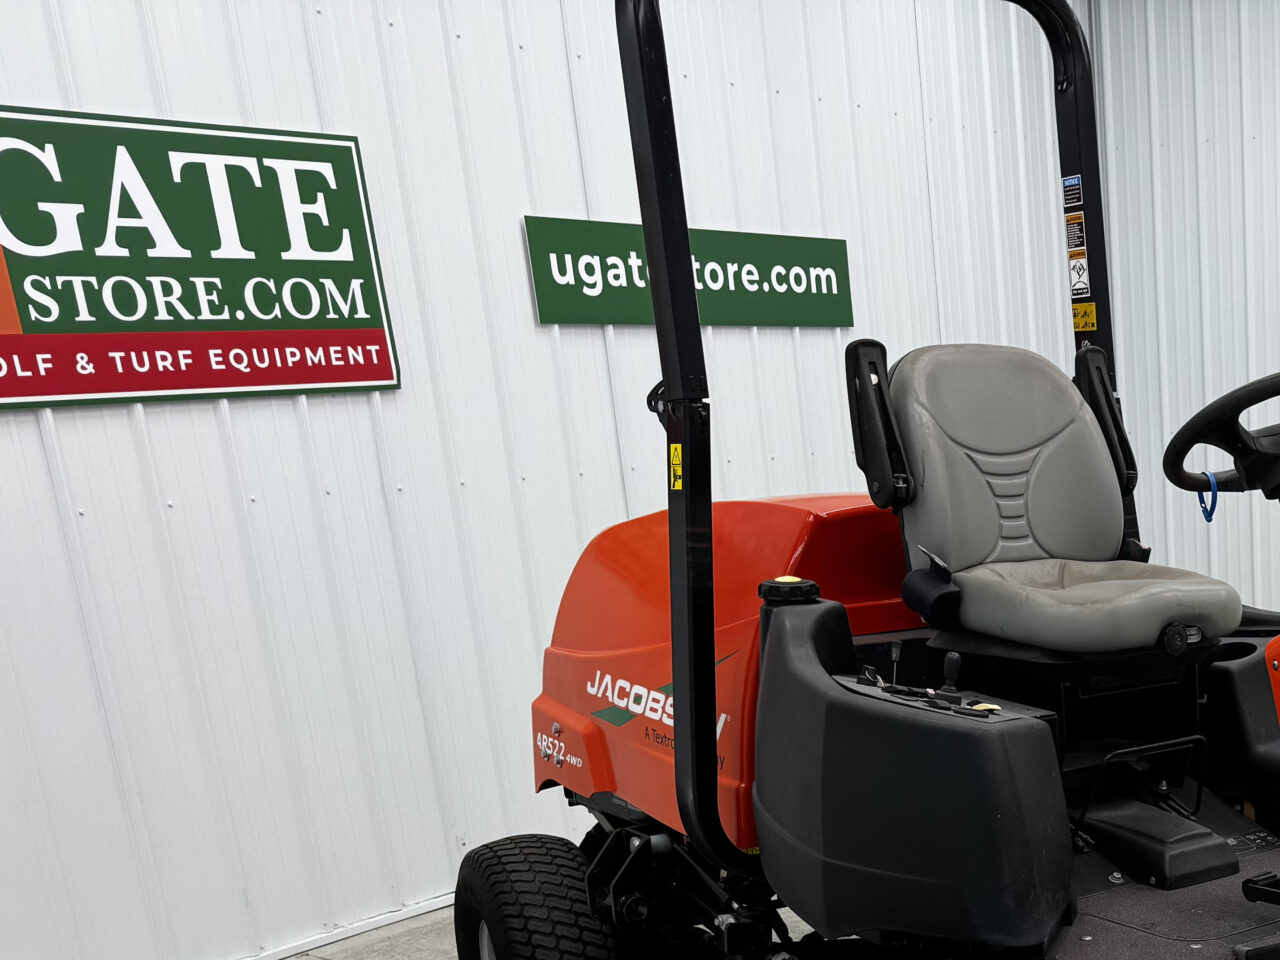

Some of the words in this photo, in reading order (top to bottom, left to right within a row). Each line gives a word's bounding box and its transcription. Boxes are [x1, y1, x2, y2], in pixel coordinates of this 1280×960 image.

[549, 251, 838, 297] ugattore.com
[23, 274, 371, 323] STORE.COM
[75, 352, 96, 375] &
[108, 350, 193, 374] TURF
[208, 345, 380, 373] EQUIPMENT
[565, 754, 583, 768] 4WD
